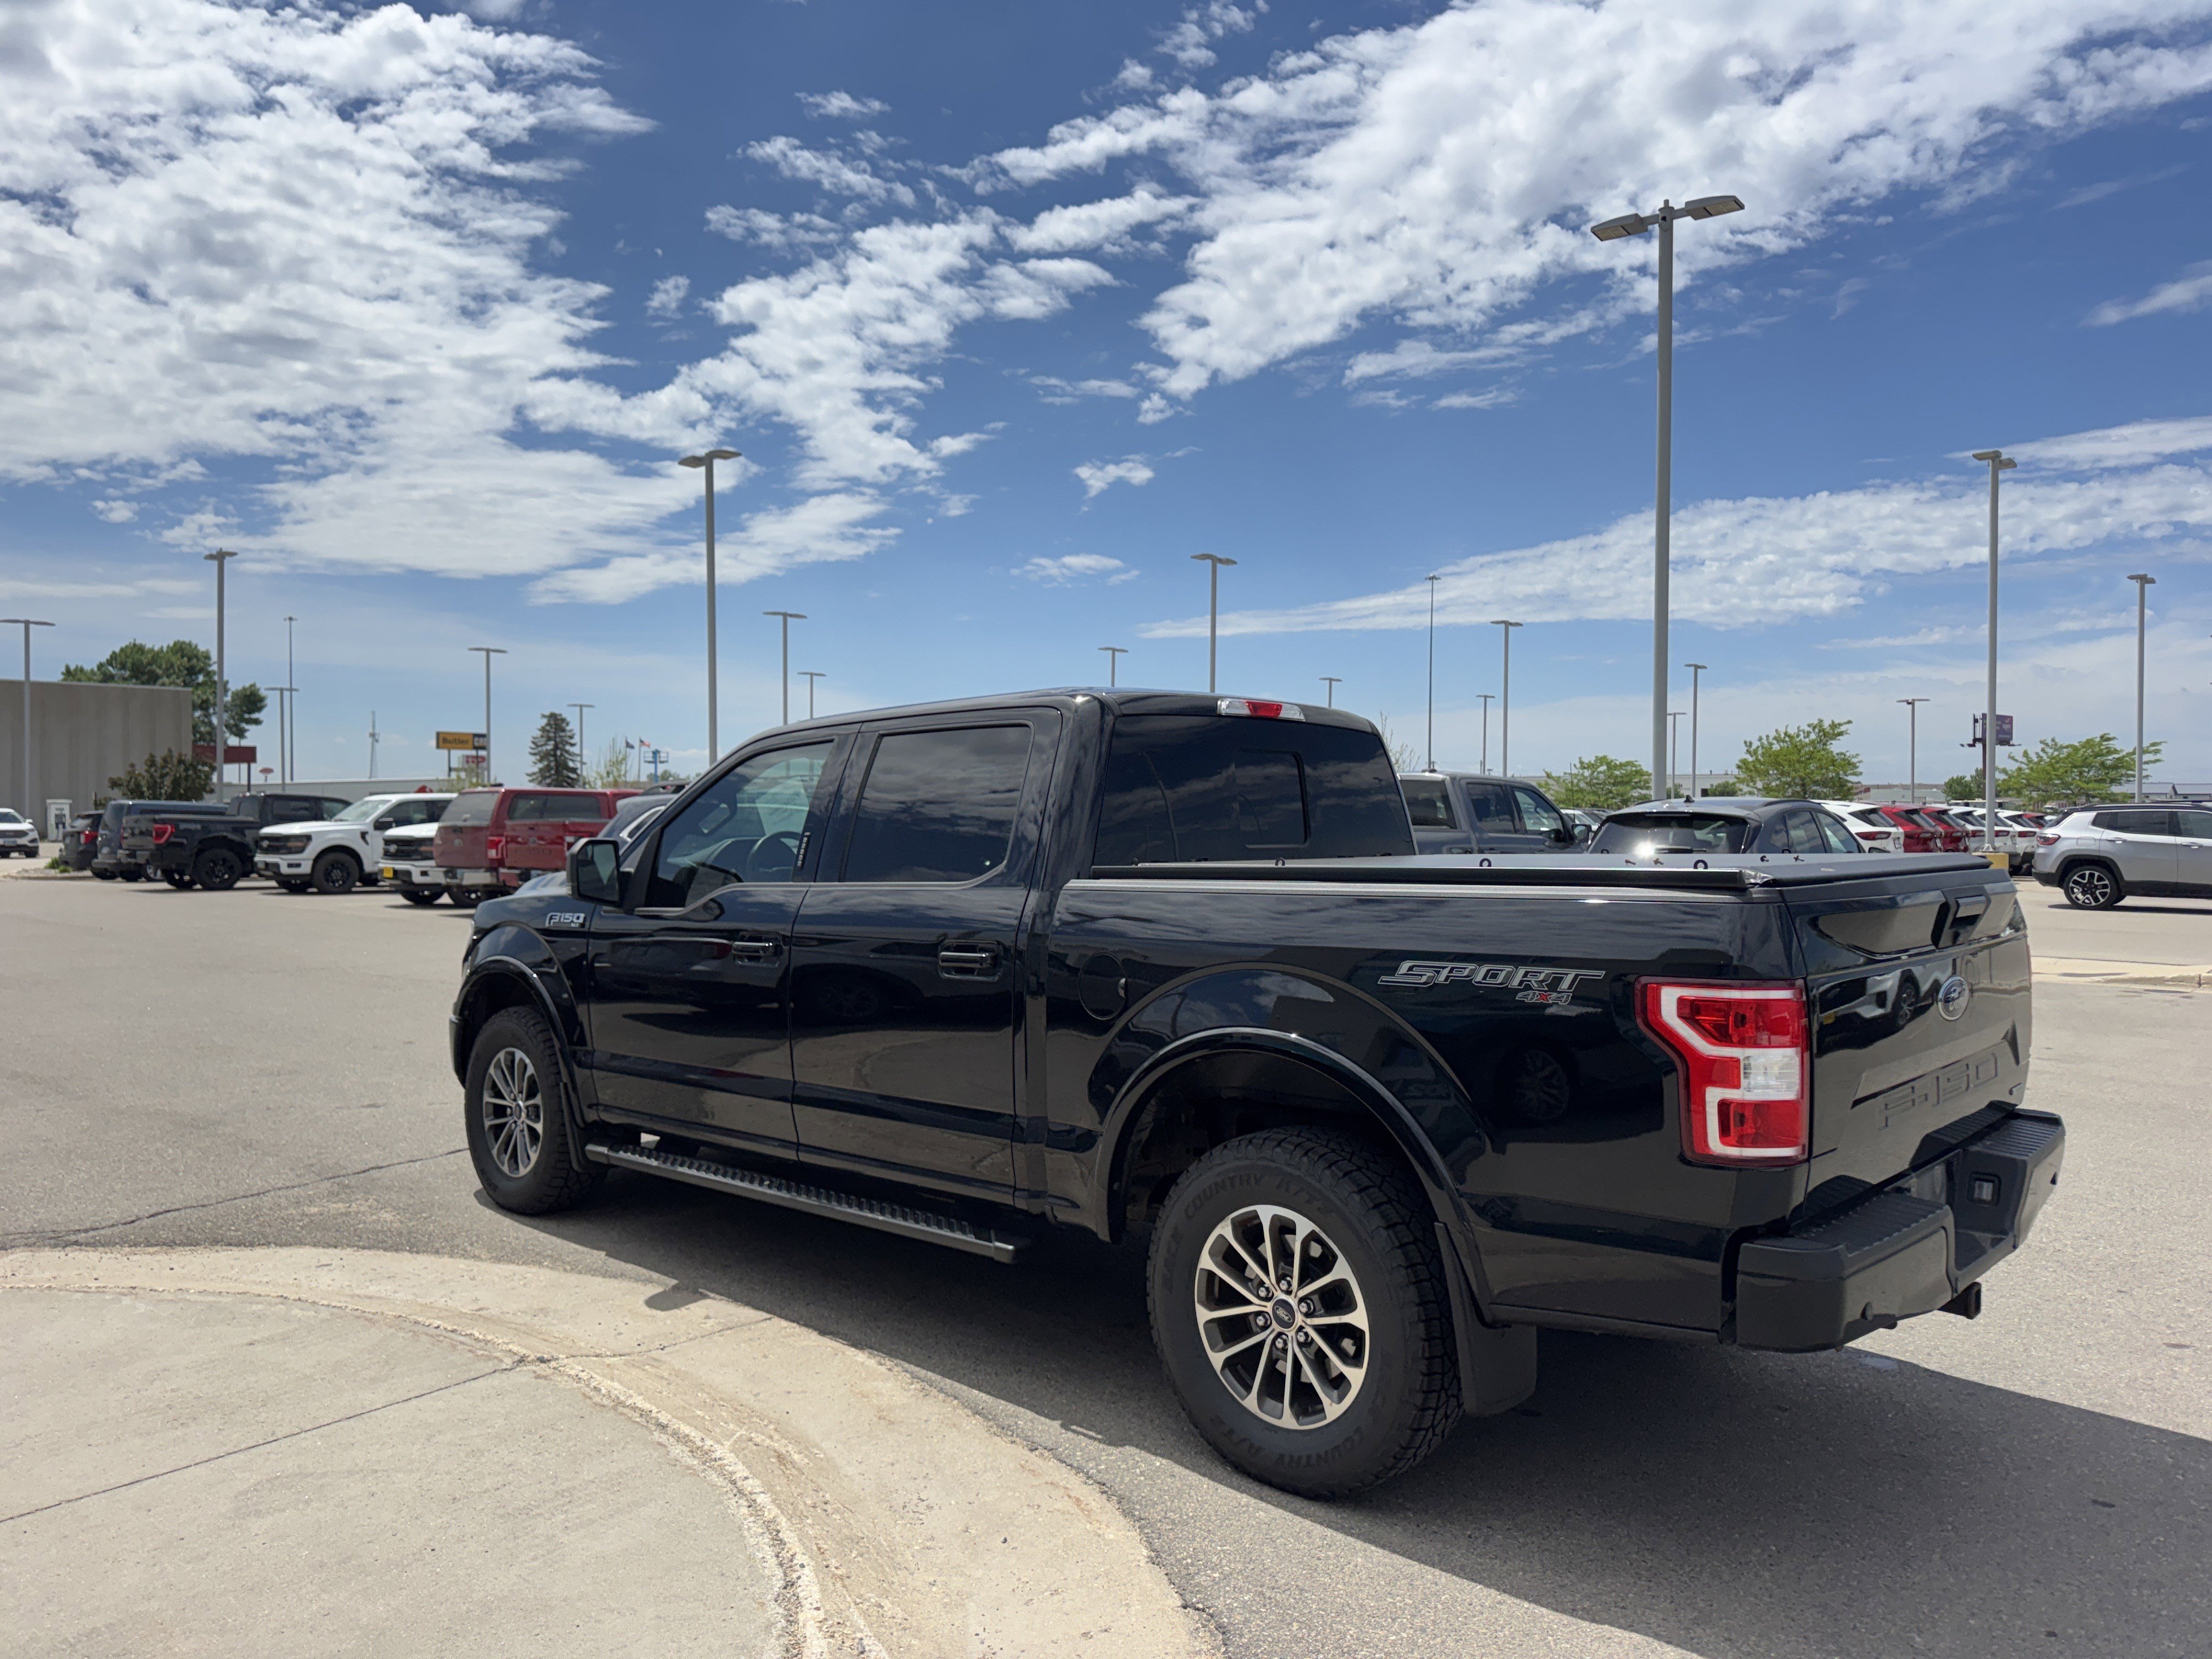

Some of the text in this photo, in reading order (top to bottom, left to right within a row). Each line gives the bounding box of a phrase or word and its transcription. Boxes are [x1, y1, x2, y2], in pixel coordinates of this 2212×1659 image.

[442, 737, 469, 745] Butler
[545, 912, 585, 927] F150
[1378, 960, 1606, 992] SPORT
[1184, 1173, 1261, 1220] COUNTRY
